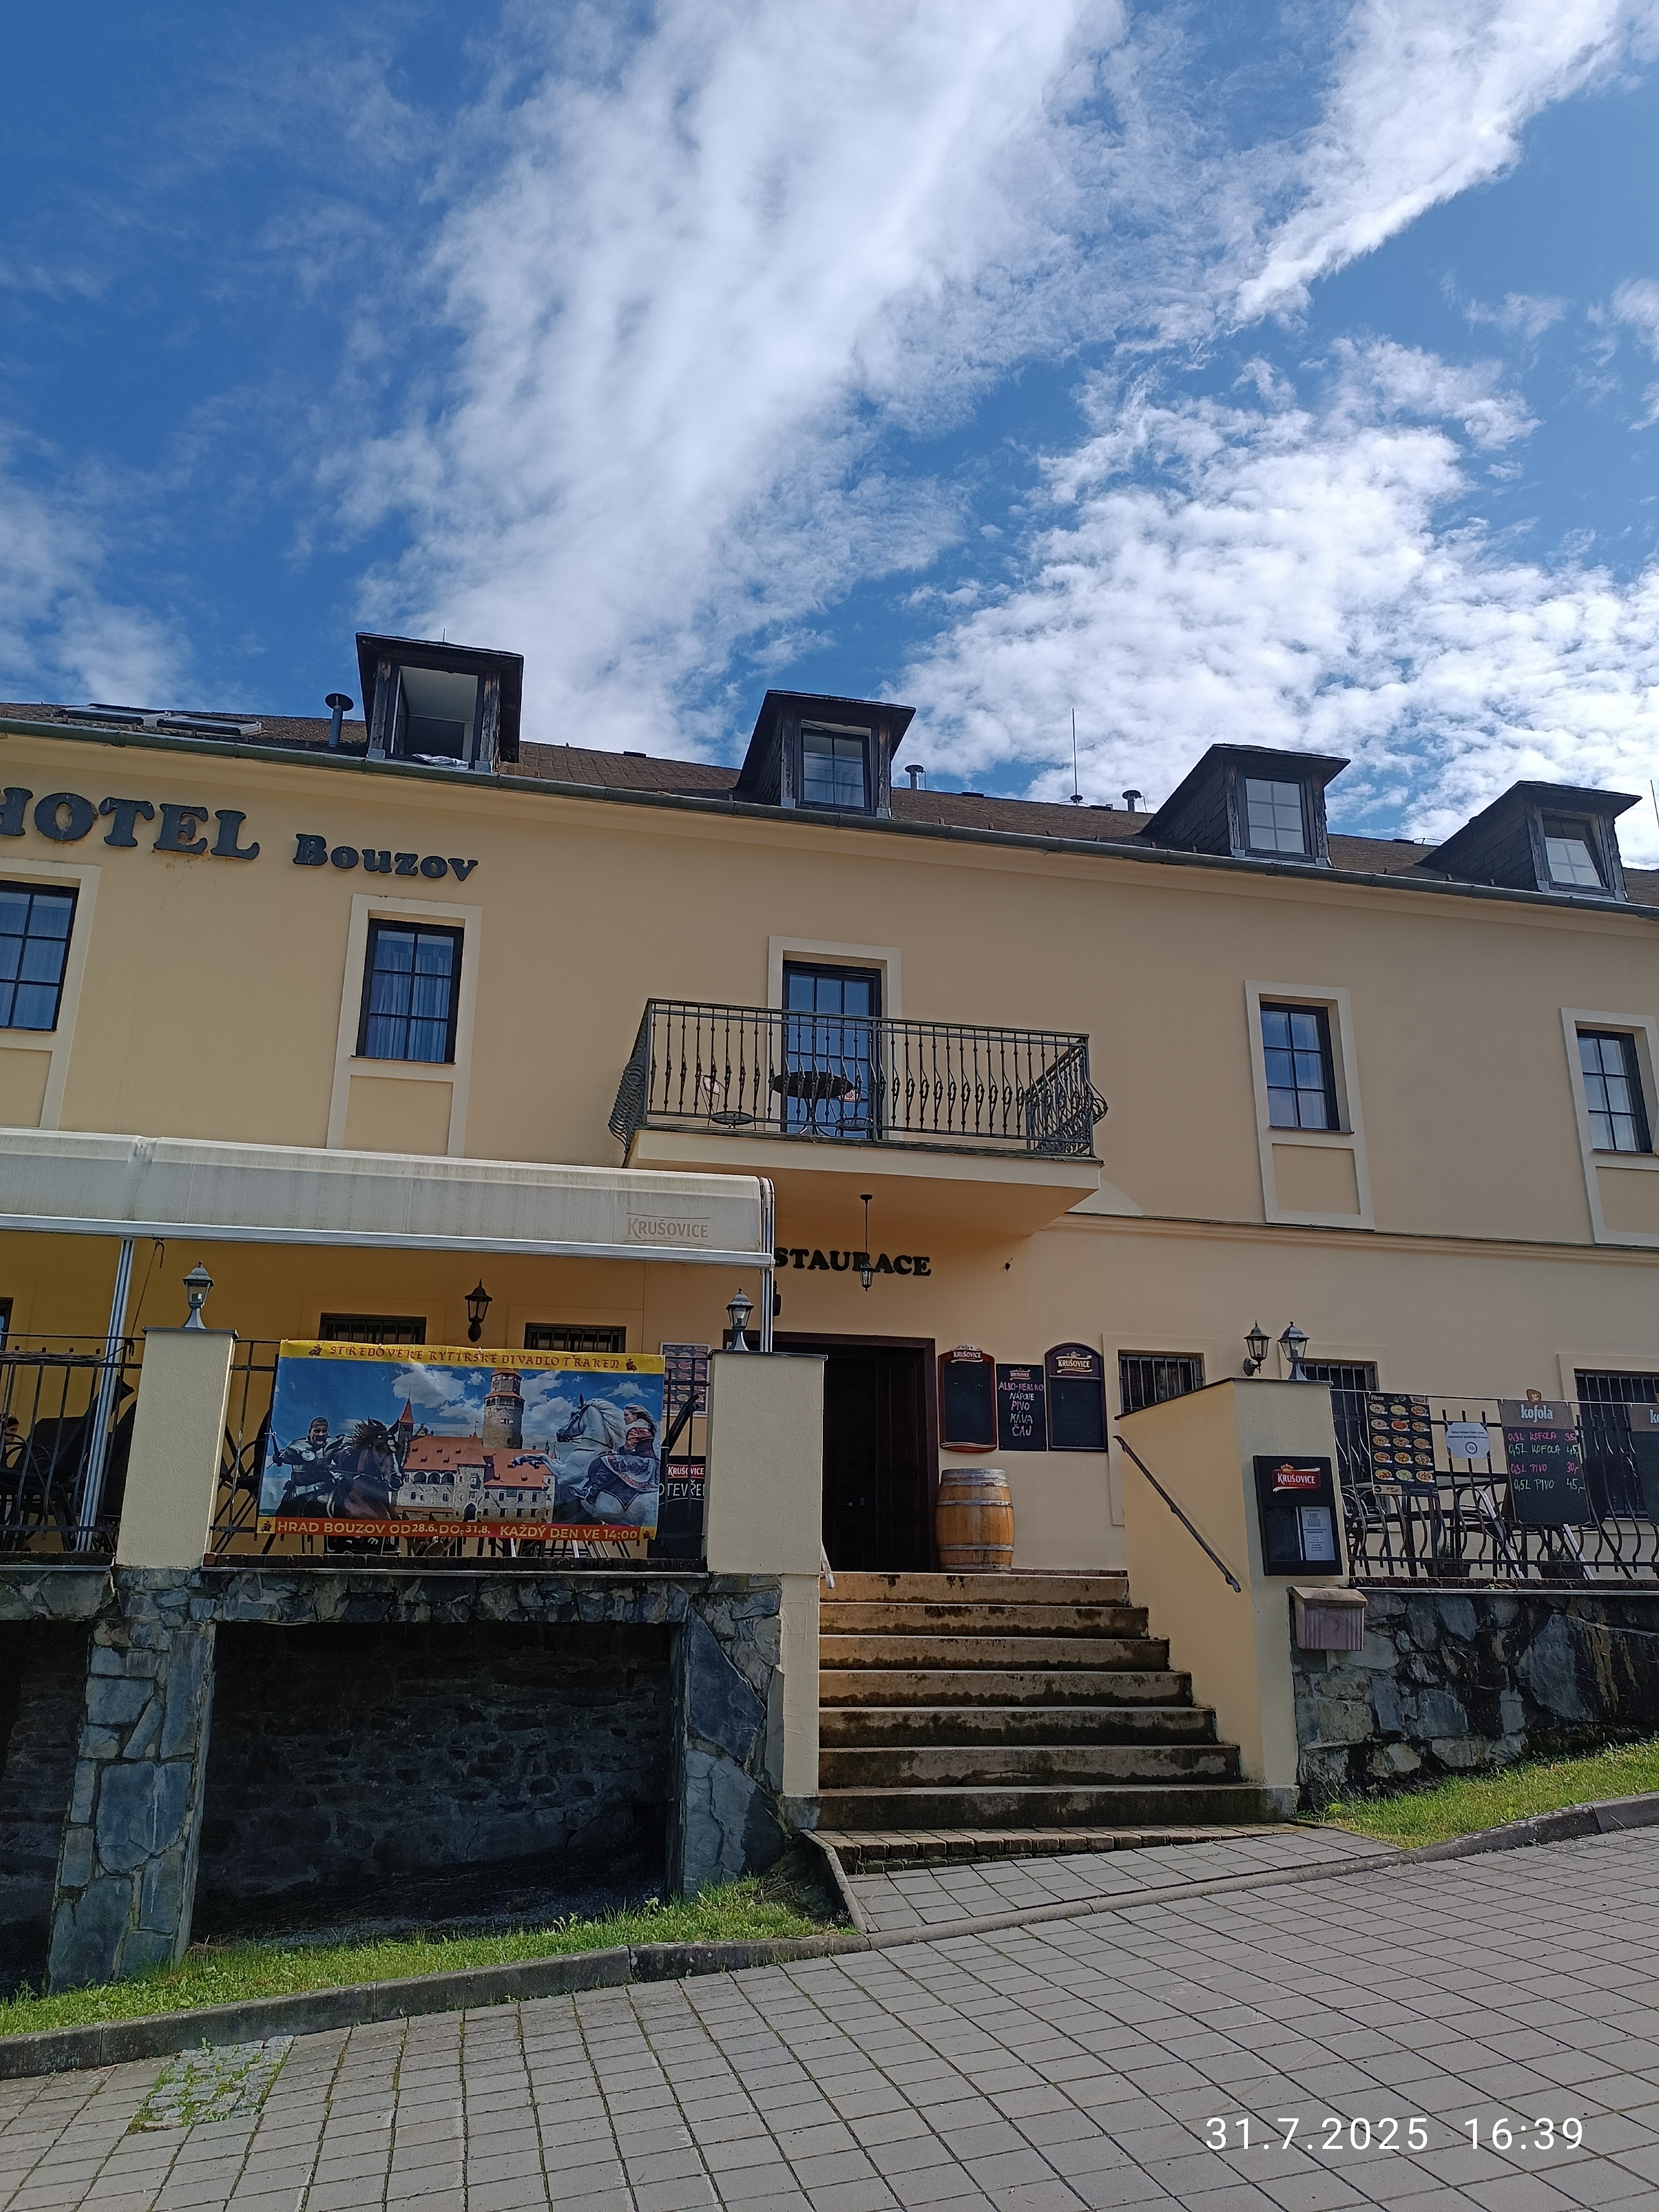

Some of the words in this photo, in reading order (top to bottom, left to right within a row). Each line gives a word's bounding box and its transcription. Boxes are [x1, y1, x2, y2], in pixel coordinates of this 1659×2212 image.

[0, 787, 260, 860] HOTEL
[293, 833, 478, 881] Bouzov
[774, 1247, 932, 1276] STAURACE
[502, 1355, 560, 1366] DIVADLO
[1058, 1359, 1090, 1368] KRUŠOVICE
[1011, 1400, 1030, 1411] PIVO
[1010, 1411, 1033, 1424] KÁVA
[1520, 1404, 1553, 1423] kofola
[1011, 1423, 1032, 1437] ČAJ
[1530, 1463, 1548, 1473] PIVO
[1277, 1473, 1316, 1485] KRUŠOVICE
[1533, 1479, 1554, 1491] PIVO
[659, 1479, 705, 1496] OTEVŘE
[278, 1521, 319, 1533] HRAD
[324, 1522, 385, 1534] BOUZOV
[389, 1524, 411, 1534] OD
[411, 1524, 438, 1533] 28.6.
[465, 1525, 491, 1533] 31.8.
[500, 1525, 547, 1537] KAŽDÝ
[550, 1528, 579, 1538] DEN
[583, 1529, 600, 1539] VE
[604, 1529, 638, 1540] 14:00
